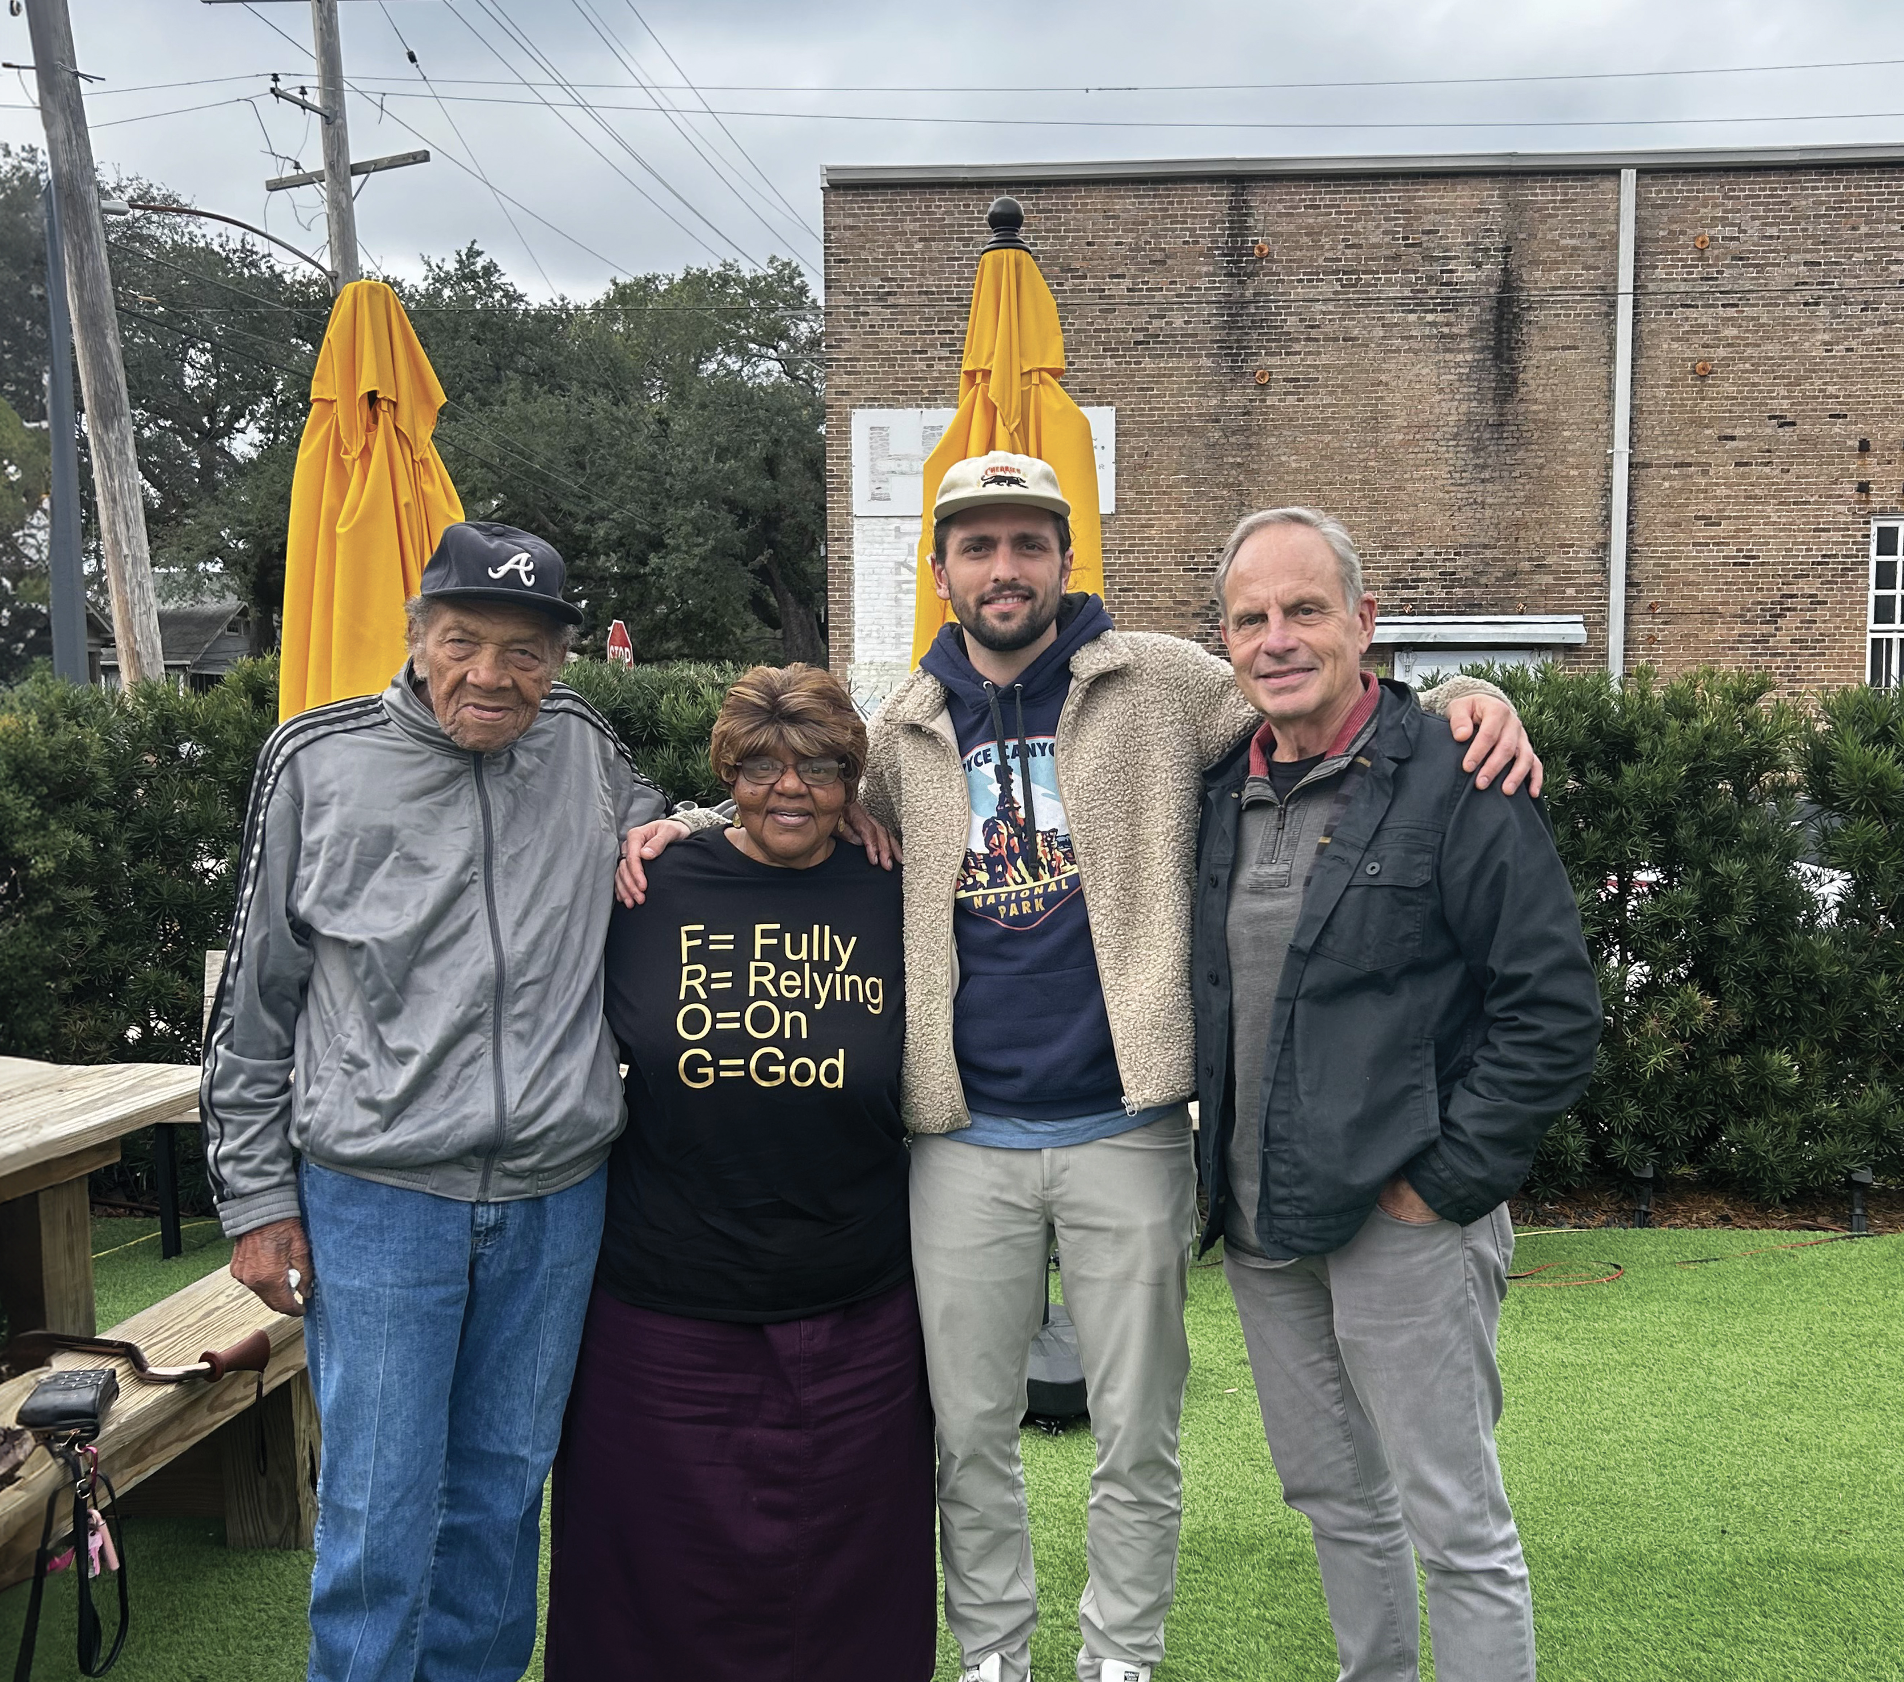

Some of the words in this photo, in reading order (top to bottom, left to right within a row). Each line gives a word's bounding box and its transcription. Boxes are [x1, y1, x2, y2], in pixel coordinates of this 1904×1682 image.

[487, 552, 536, 587] A
[962, 747, 993, 773] YCE
[972, 878, 1069, 909] NATIONAL
[998, 897, 1046, 919] PARK
[680, 924, 735, 964] F=
[754, 923, 857, 972] Fully
[678, 963, 733, 1000] R=
[748, 961, 883, 1014] Relying
[676, 1000, 808, 1040] O=On
[678, 1046, 845, 1089] G=God
